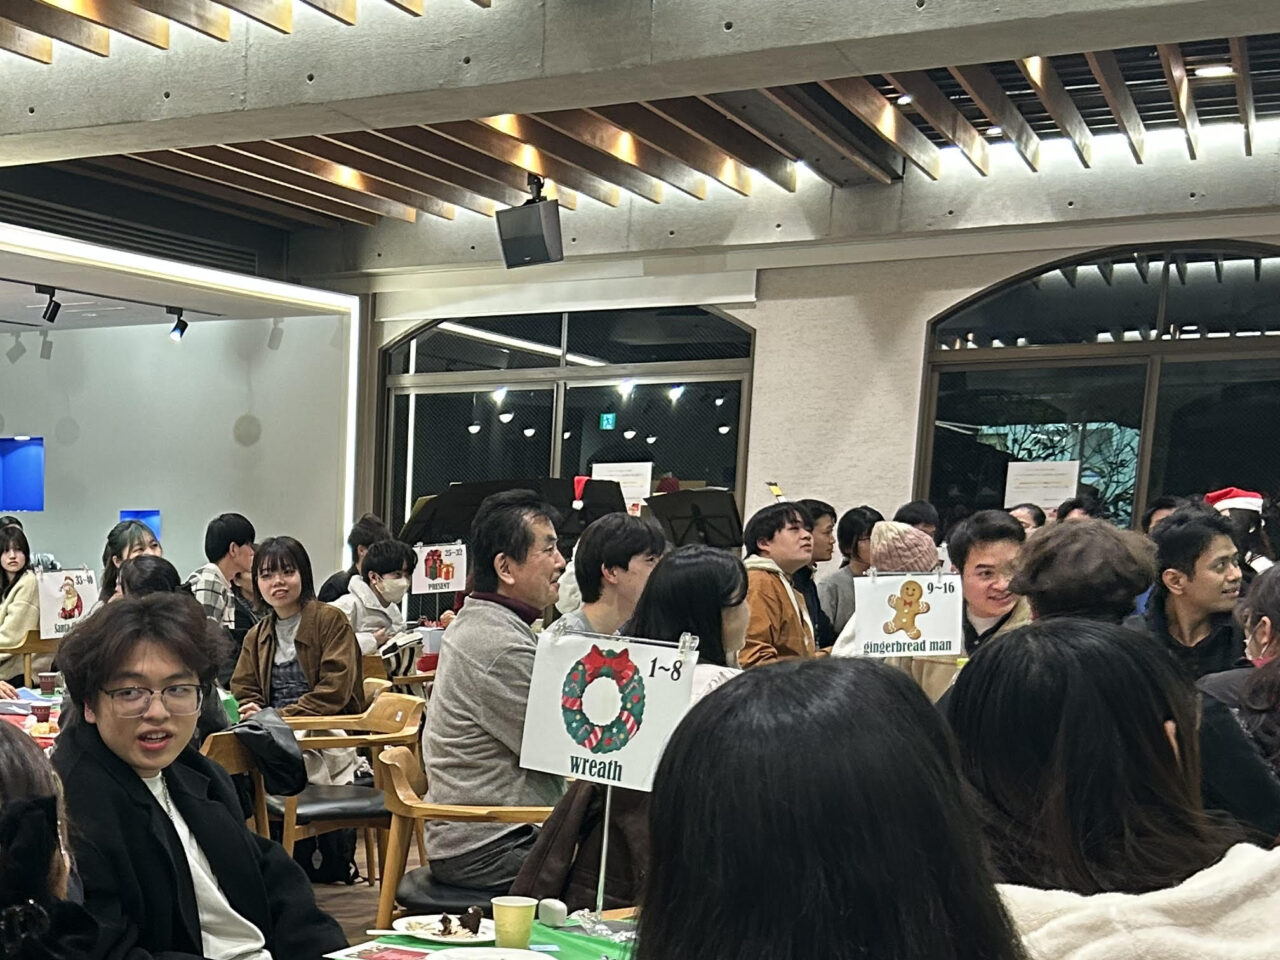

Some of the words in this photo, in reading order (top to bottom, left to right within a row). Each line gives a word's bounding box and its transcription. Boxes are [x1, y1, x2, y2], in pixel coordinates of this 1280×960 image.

[927, 582, 955, 594] 9~16
[863, 640, 926, 655] gingerbread
[929, 640, 952, 651] man
[570, 755, 623, 782] wreath
